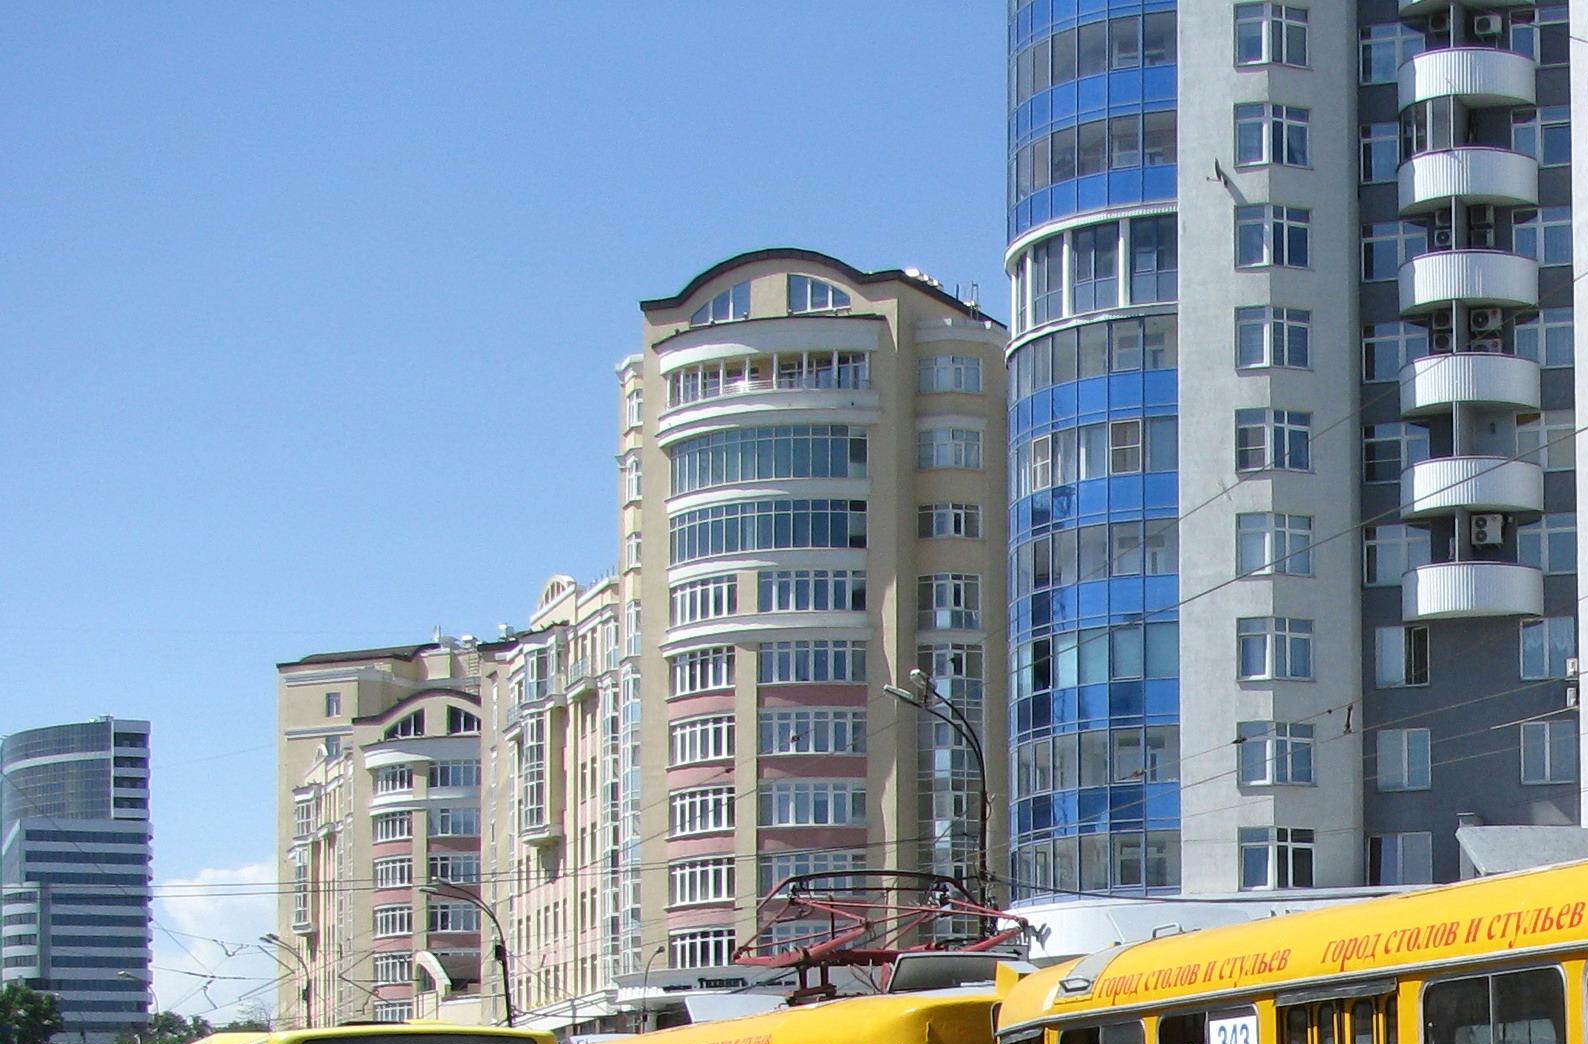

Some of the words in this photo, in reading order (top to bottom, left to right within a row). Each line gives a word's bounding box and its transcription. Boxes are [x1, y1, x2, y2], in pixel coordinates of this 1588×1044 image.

[1321, 931, 1381, 972] город
[1383, 919, 1460, 955] столов
[1464, 916, 1484, 944] и
[1487, 900, 1586, 948] стульев
[1099, 973, 1142, 1005] город
[1144, 963, 1200, 991] столов
[1203, 960, 1218, 982] и
[1219, 948, 1291, 988] стульев
